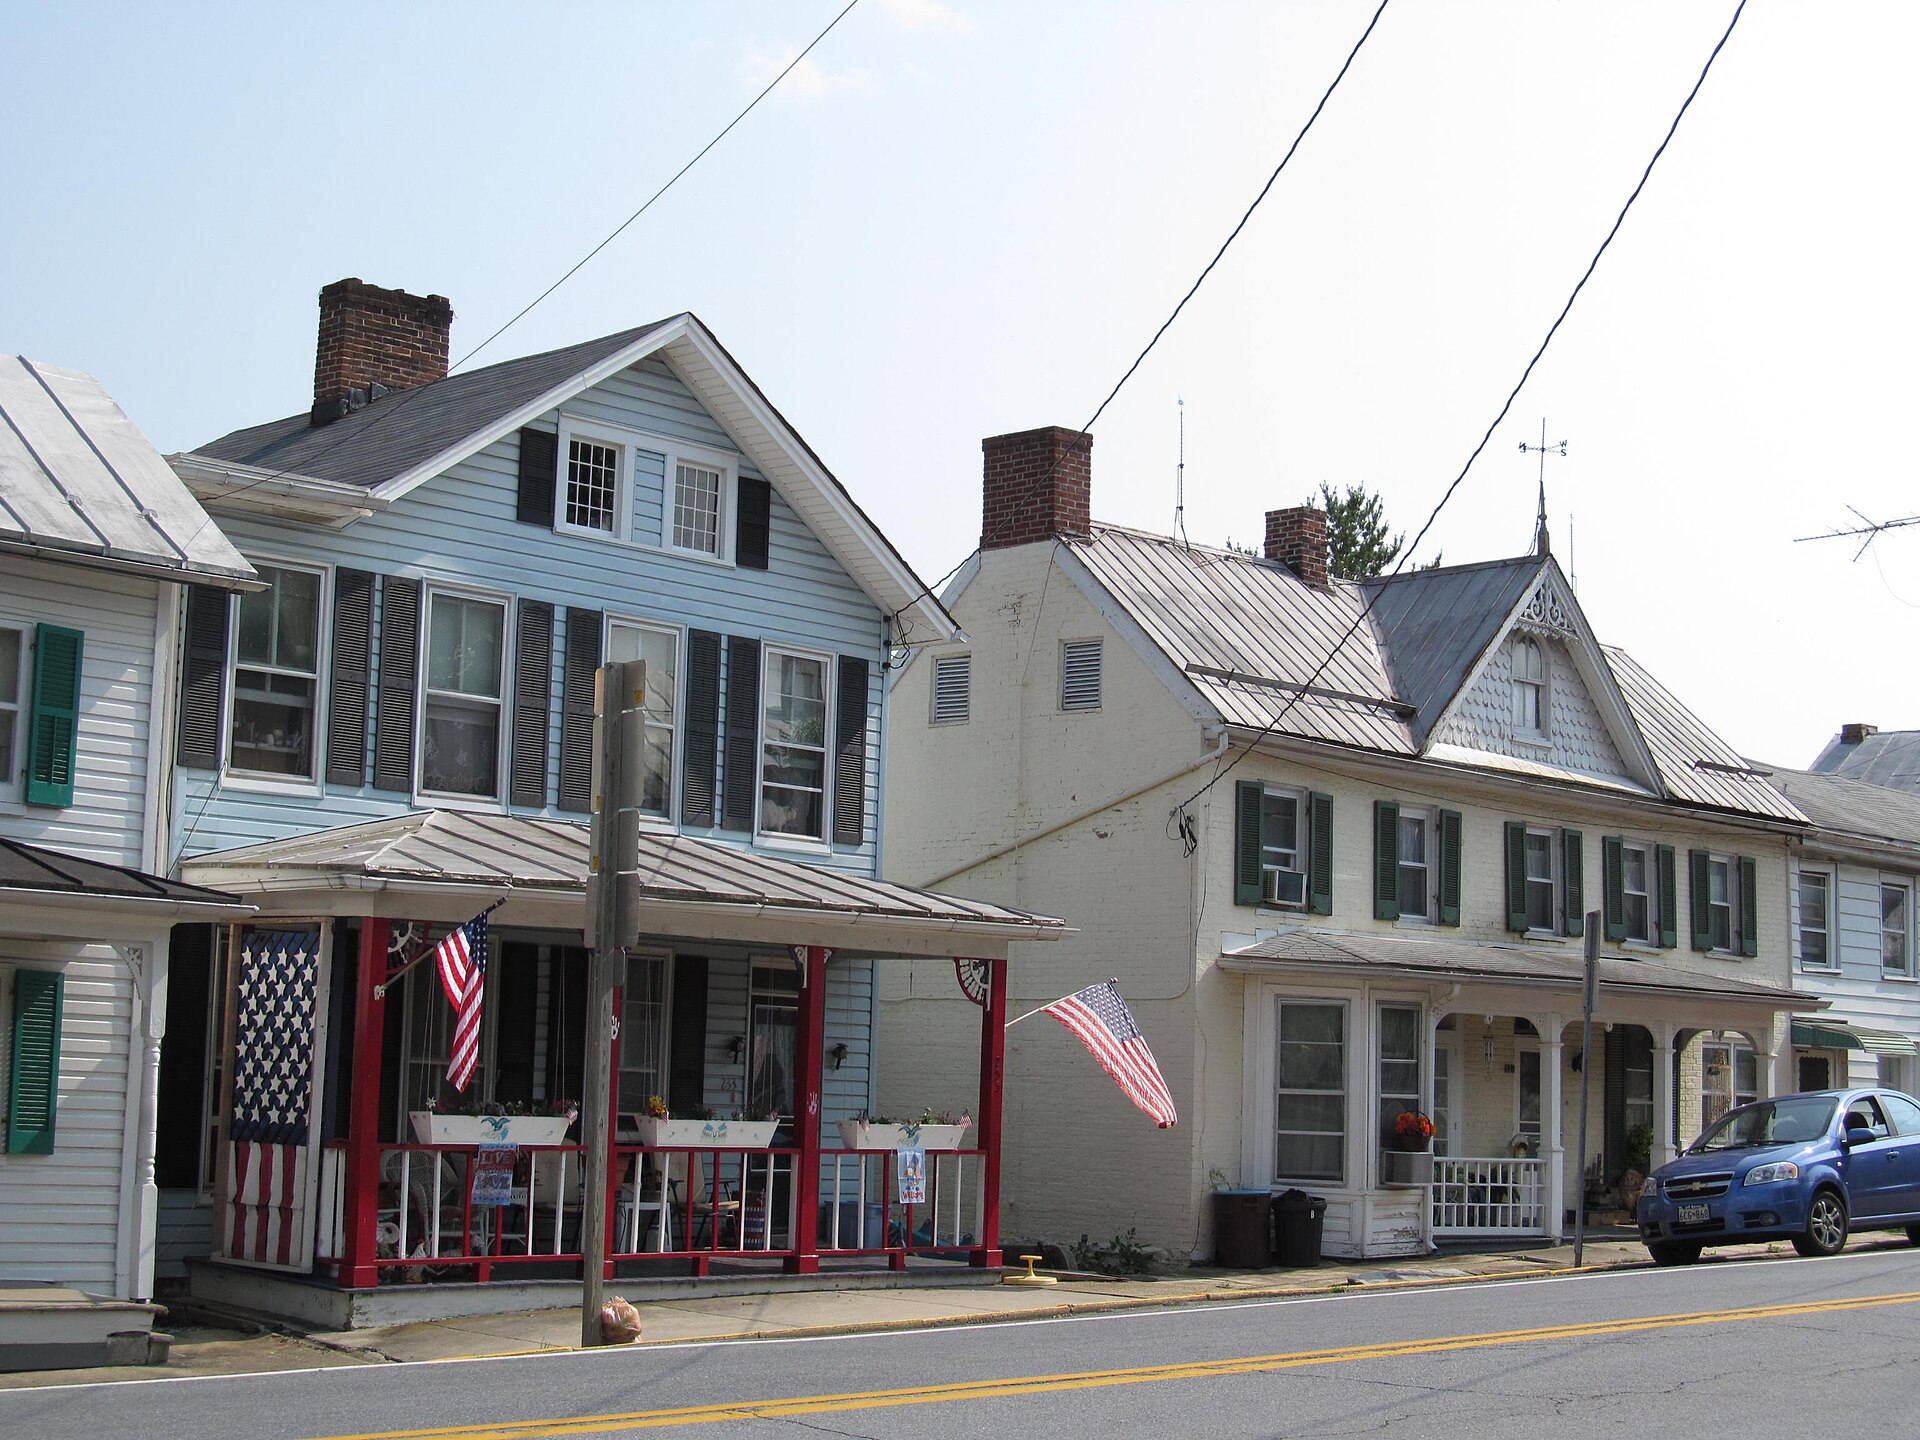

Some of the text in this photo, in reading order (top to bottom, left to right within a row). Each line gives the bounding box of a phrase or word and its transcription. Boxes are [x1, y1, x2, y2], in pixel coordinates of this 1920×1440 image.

[1559, 439, 1568, 448] W
[1560, 448, 1567, 457] S
[720, 1076, 737, 1091] 233
[902, 1191, 924, 1200] WELCOME
